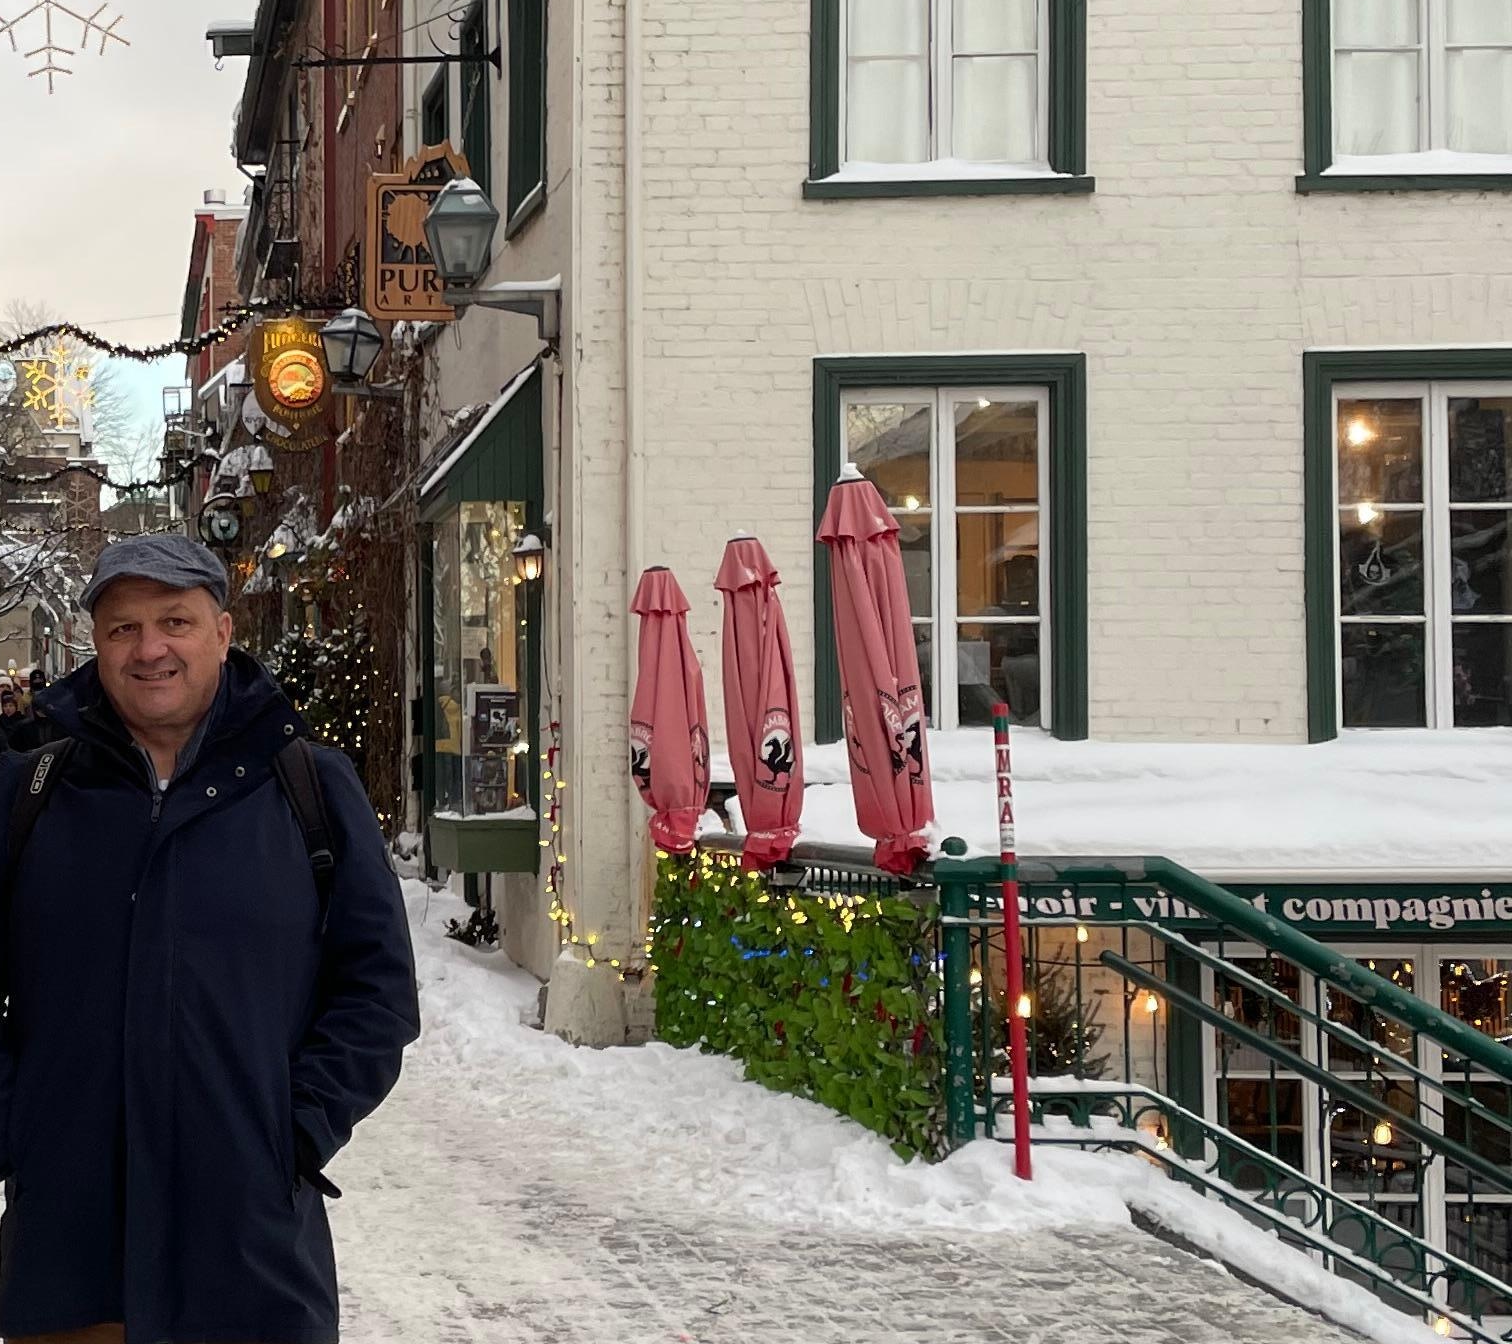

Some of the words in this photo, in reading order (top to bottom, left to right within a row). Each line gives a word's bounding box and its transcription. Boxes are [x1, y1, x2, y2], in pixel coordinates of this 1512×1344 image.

[380, 269, 448, 292] PUR
[1132, 890, 1208, 919] vin
[1282, 888, 1512, 930] compagnie
